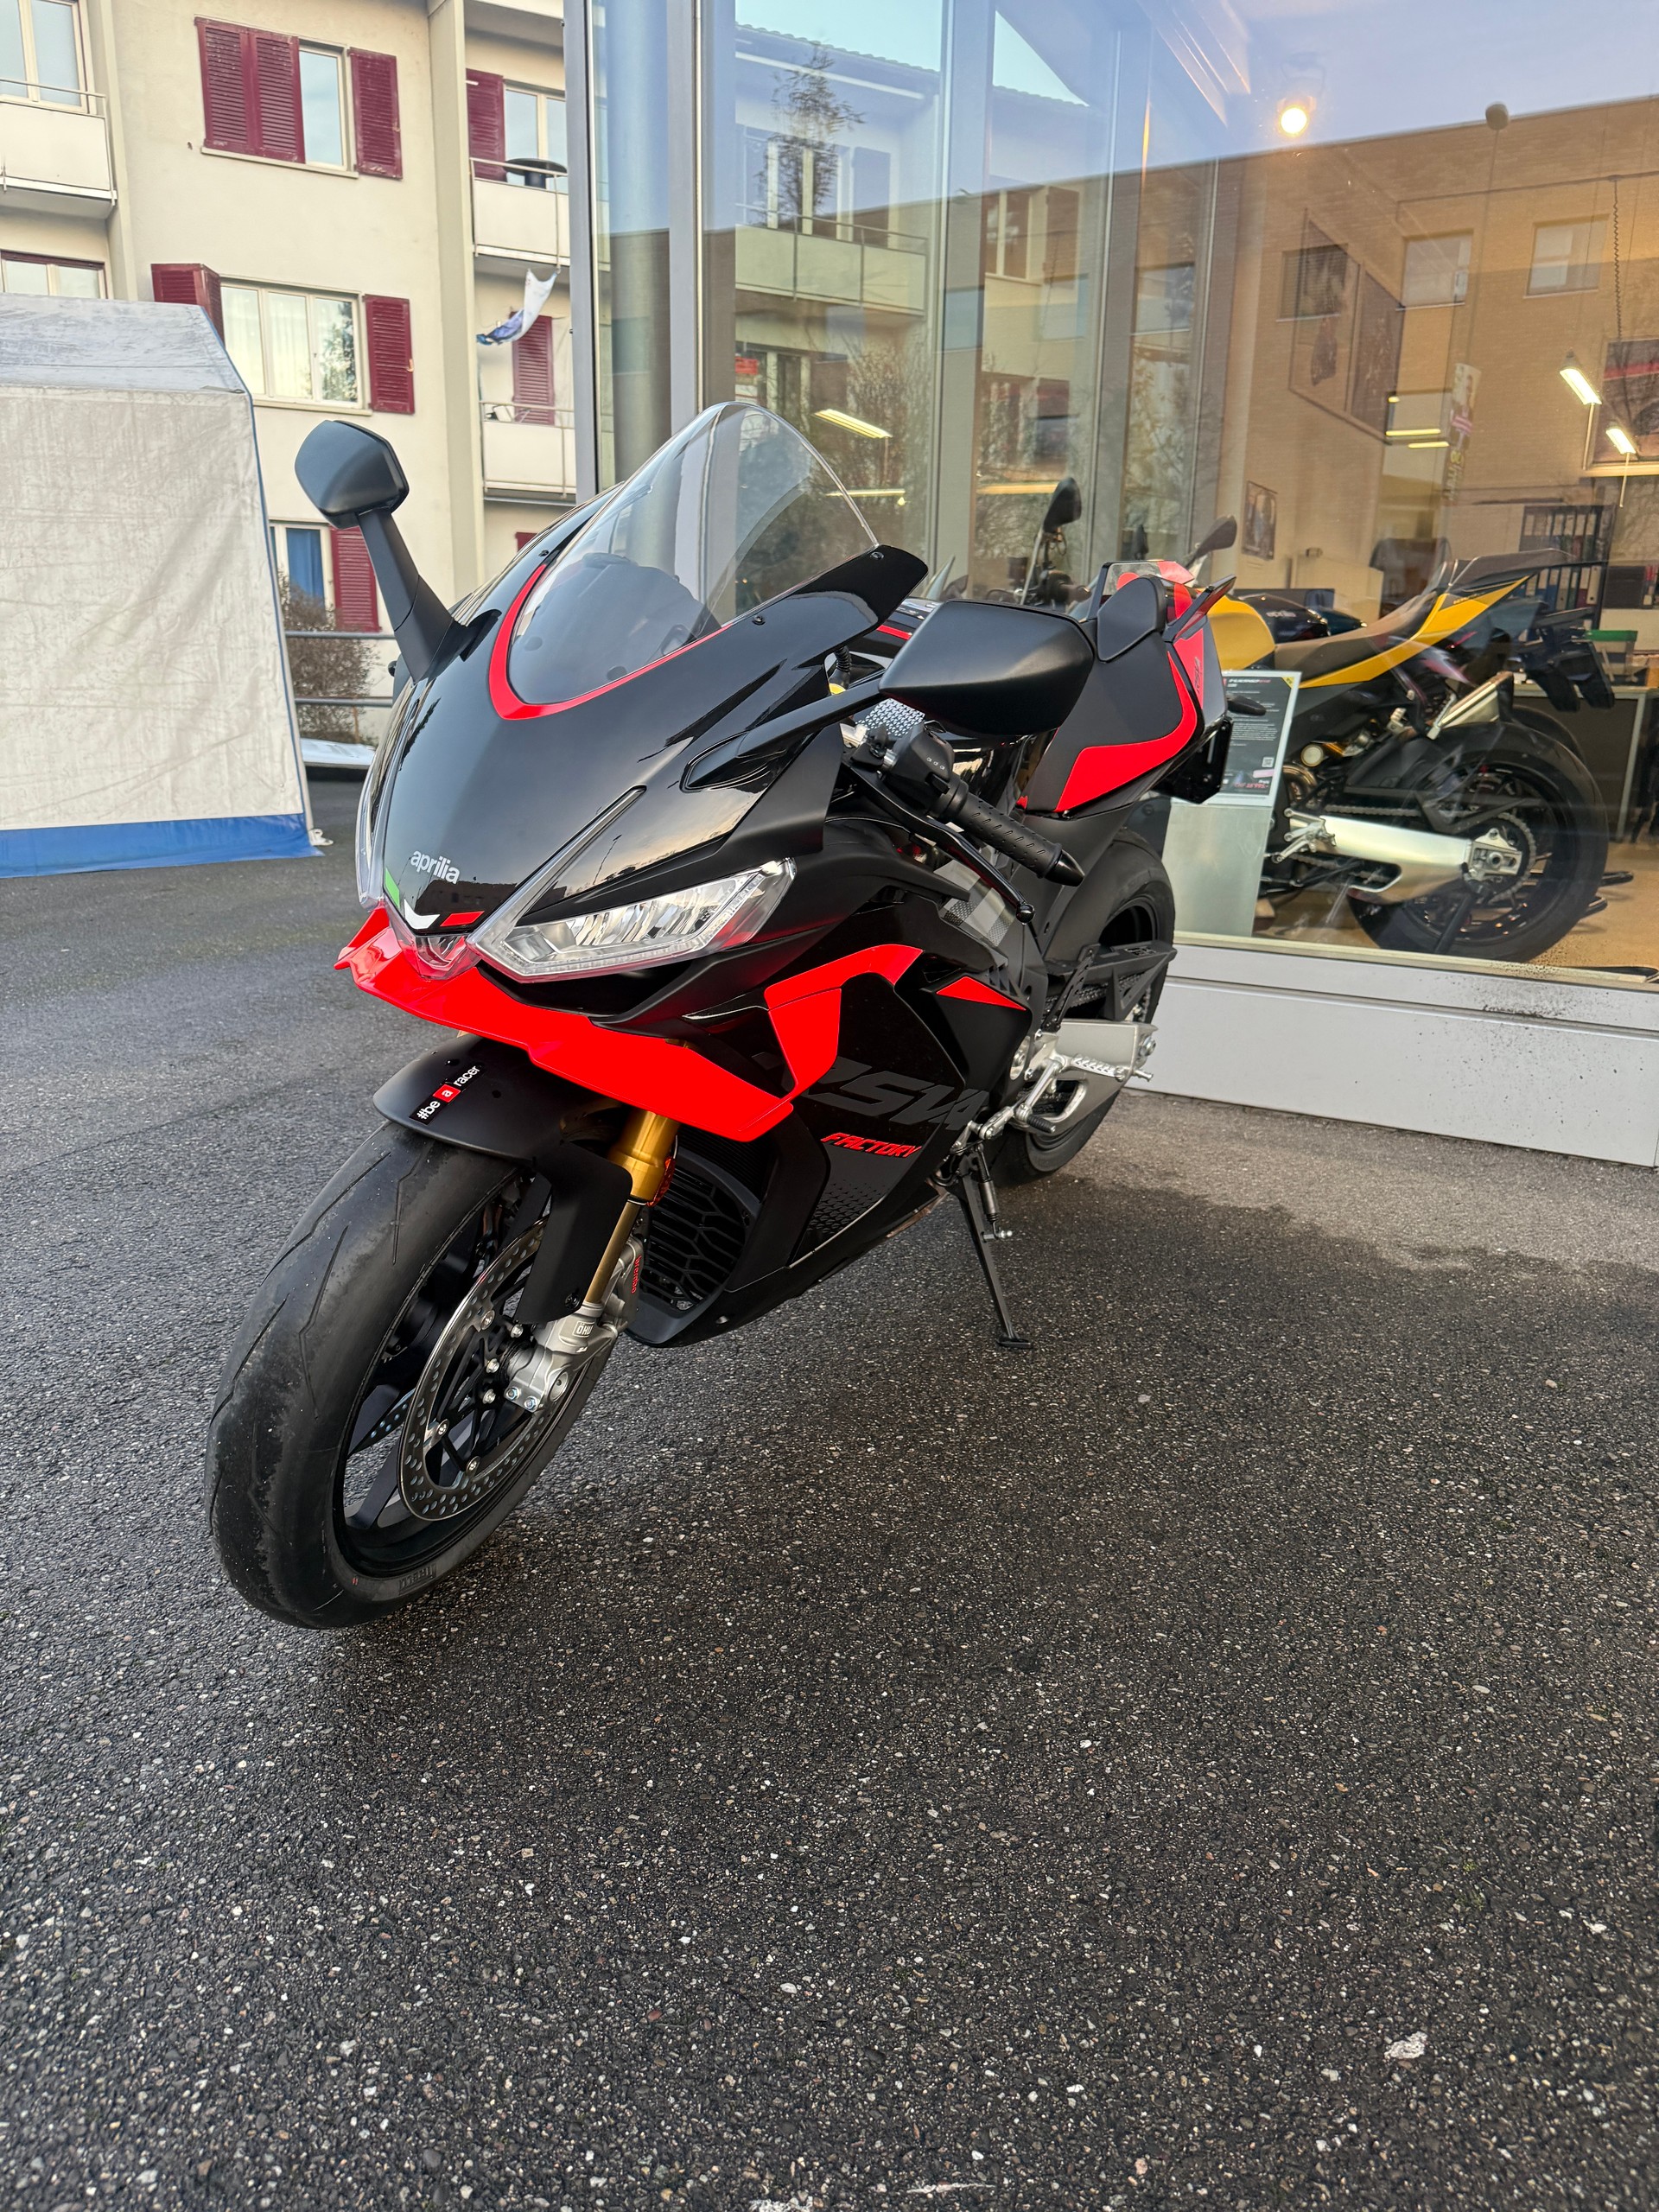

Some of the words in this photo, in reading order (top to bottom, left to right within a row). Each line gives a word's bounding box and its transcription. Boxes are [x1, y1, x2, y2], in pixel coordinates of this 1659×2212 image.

[410, 851, 460, 884] aprilia
[416, 1101, 441, 1120] #be
[453, 1065, 480, 1087] racer
[820, 1132, 922, 1158] FACTORY
[631, 1255, 642, 1294] brembo
